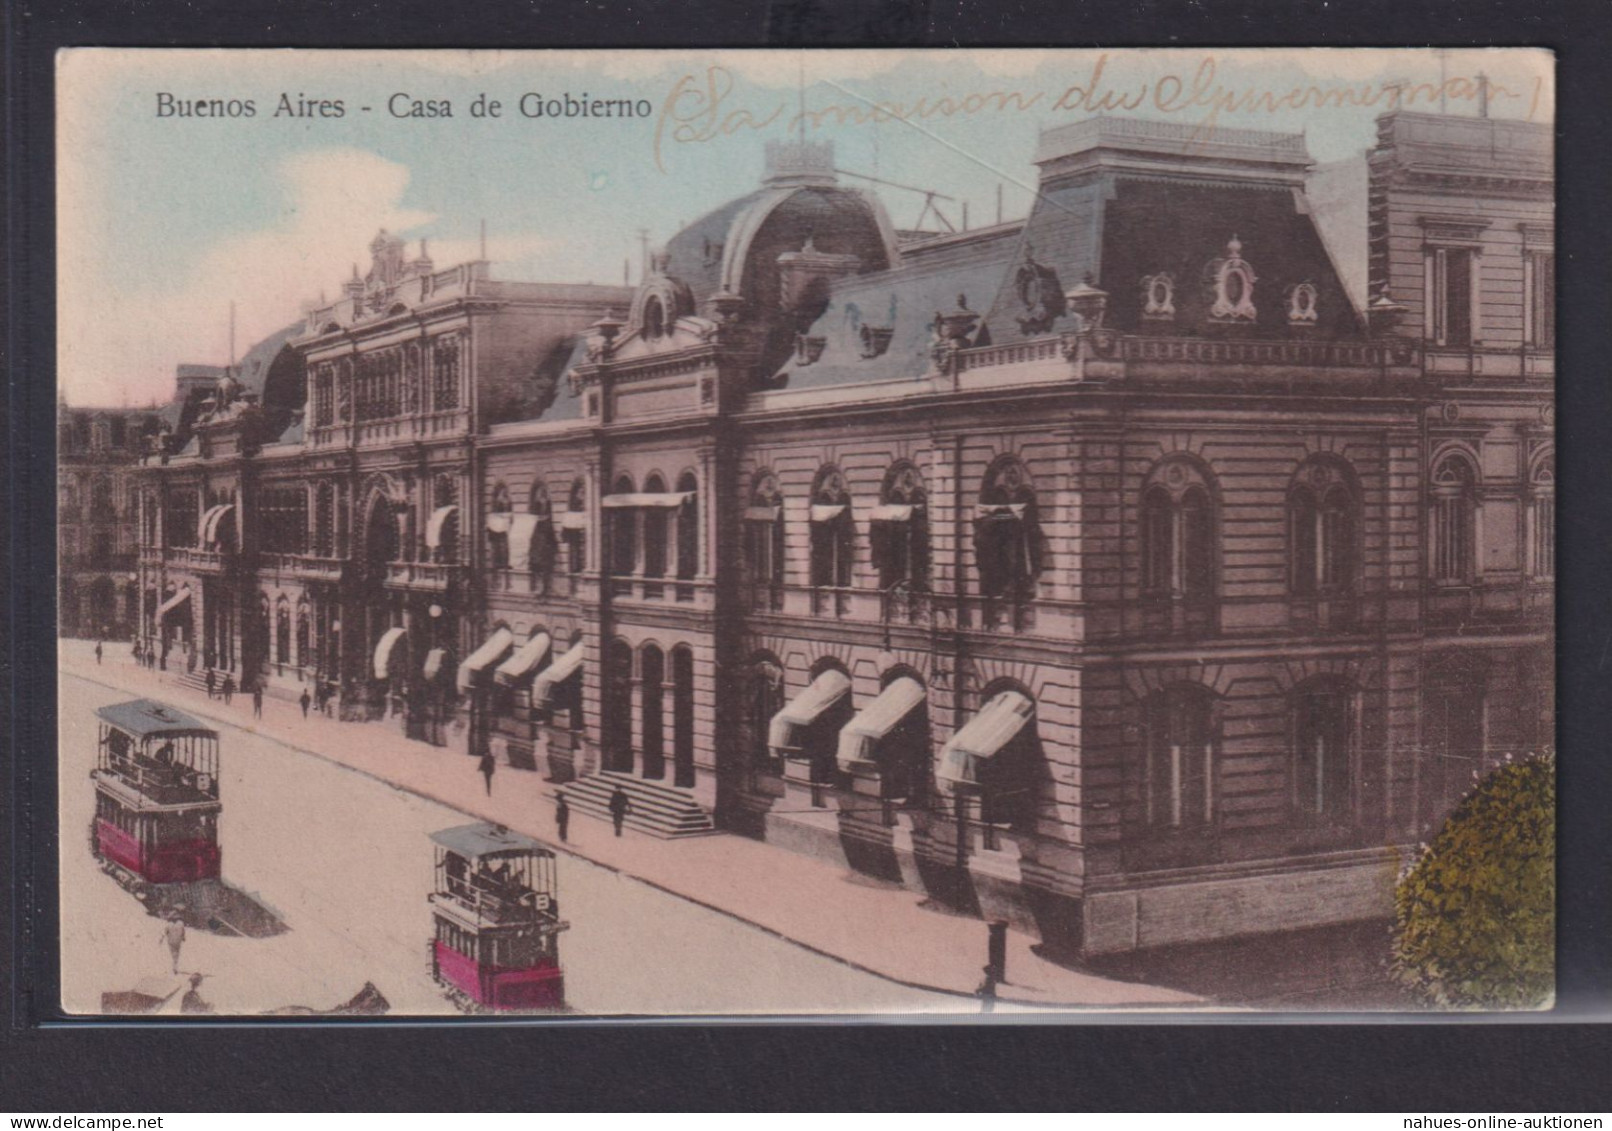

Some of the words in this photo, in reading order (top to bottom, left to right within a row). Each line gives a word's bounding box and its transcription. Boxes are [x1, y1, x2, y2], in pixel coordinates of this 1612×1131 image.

[155, 92, 257, 118] Buenos
[273, 91, 346, 118] Aires
[388, 92, 454, 118] Casa
[469, 92, 503, 118] de
[519, 91, 653, 119] Gobierno
[788, 82, 1045, 133] maison
[1052, 54, 1147, 113] du
